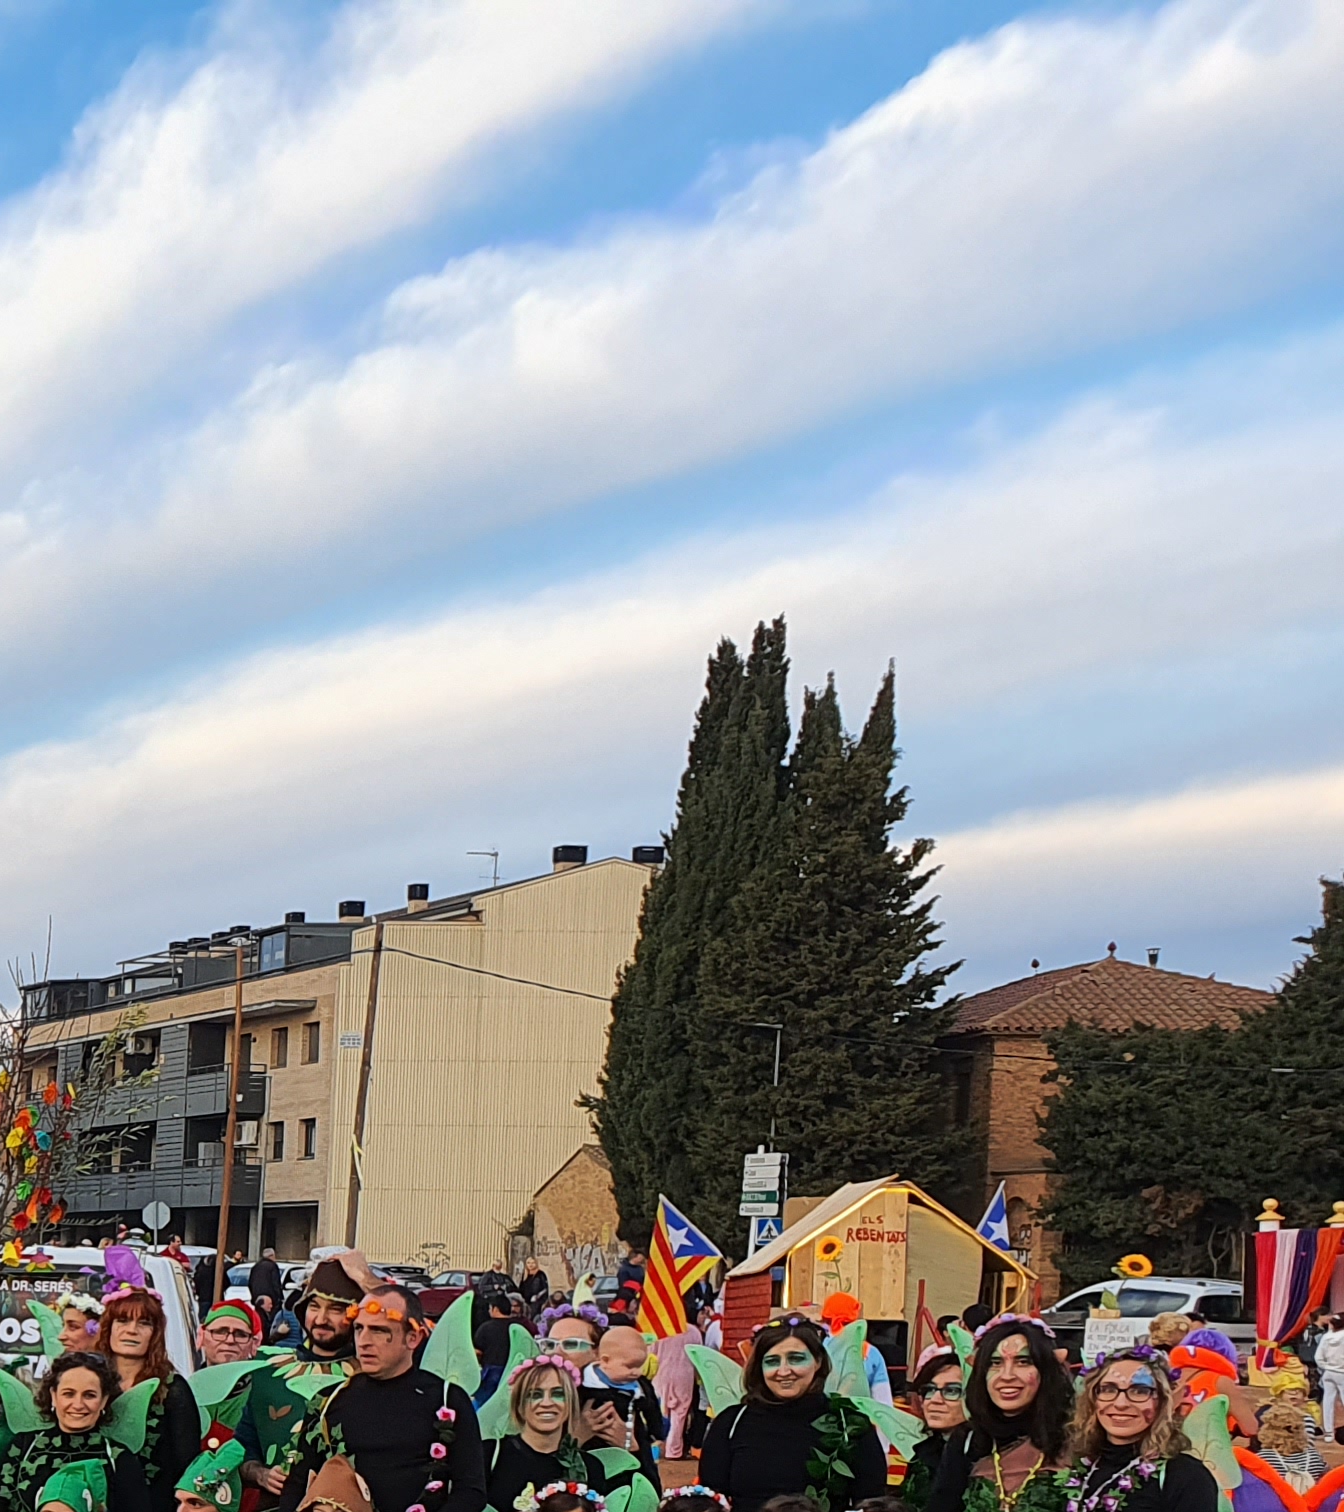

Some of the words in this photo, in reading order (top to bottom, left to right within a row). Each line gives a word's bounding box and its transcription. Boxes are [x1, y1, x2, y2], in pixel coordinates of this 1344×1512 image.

[861, 1215, 884, 1224] ELS
[845, 1227, 907, 1244] REBENTATS
[12, 1280, 33, 1291] DR.
[34, 1276, 73, 1293] SERÉS
